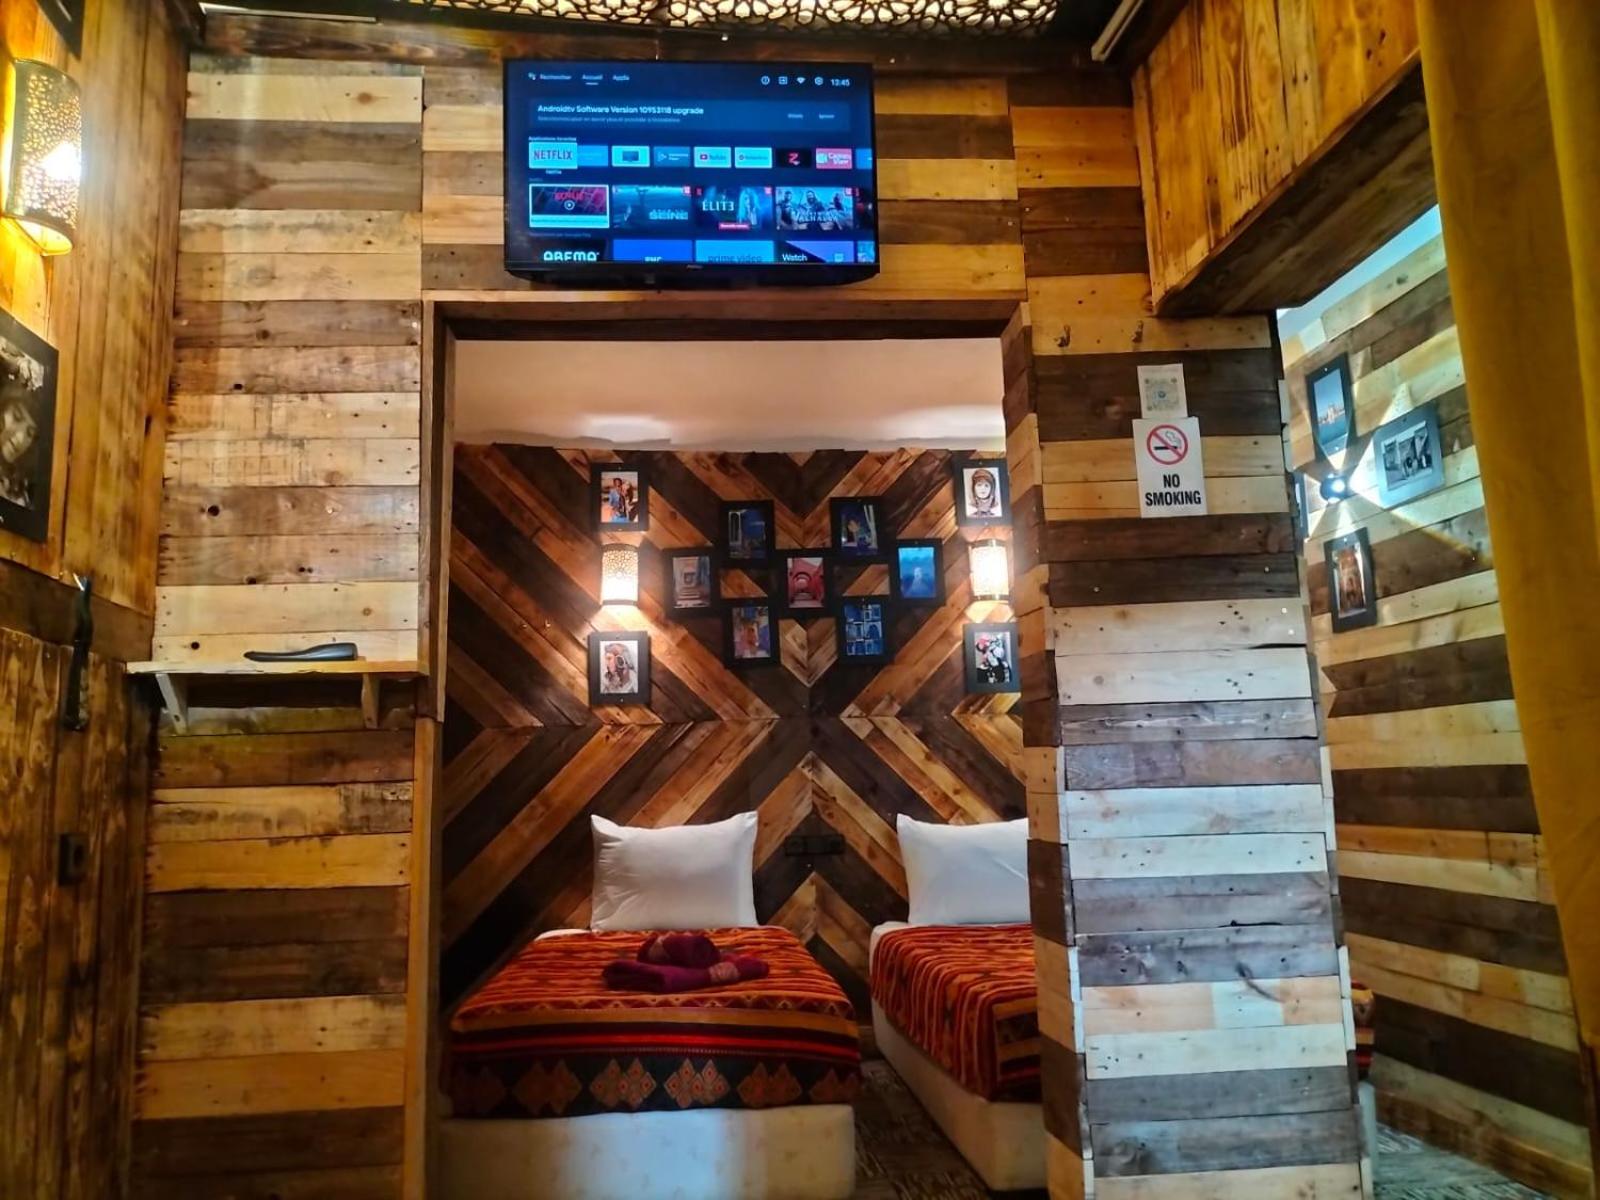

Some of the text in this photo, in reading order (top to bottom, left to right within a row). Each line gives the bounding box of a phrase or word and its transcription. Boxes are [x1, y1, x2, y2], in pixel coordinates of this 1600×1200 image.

[576, 104, 609, 114] Software
[610, 105, 638, 114] Version
[673, 107, 704, 116] upgrade
[533, 149, 573, 161] NETFLIX
[782, 253, 808, 262] Watch
[1162, 473, 1181, 489] NO
[1144, 490, 1202, 507] SMOKING
